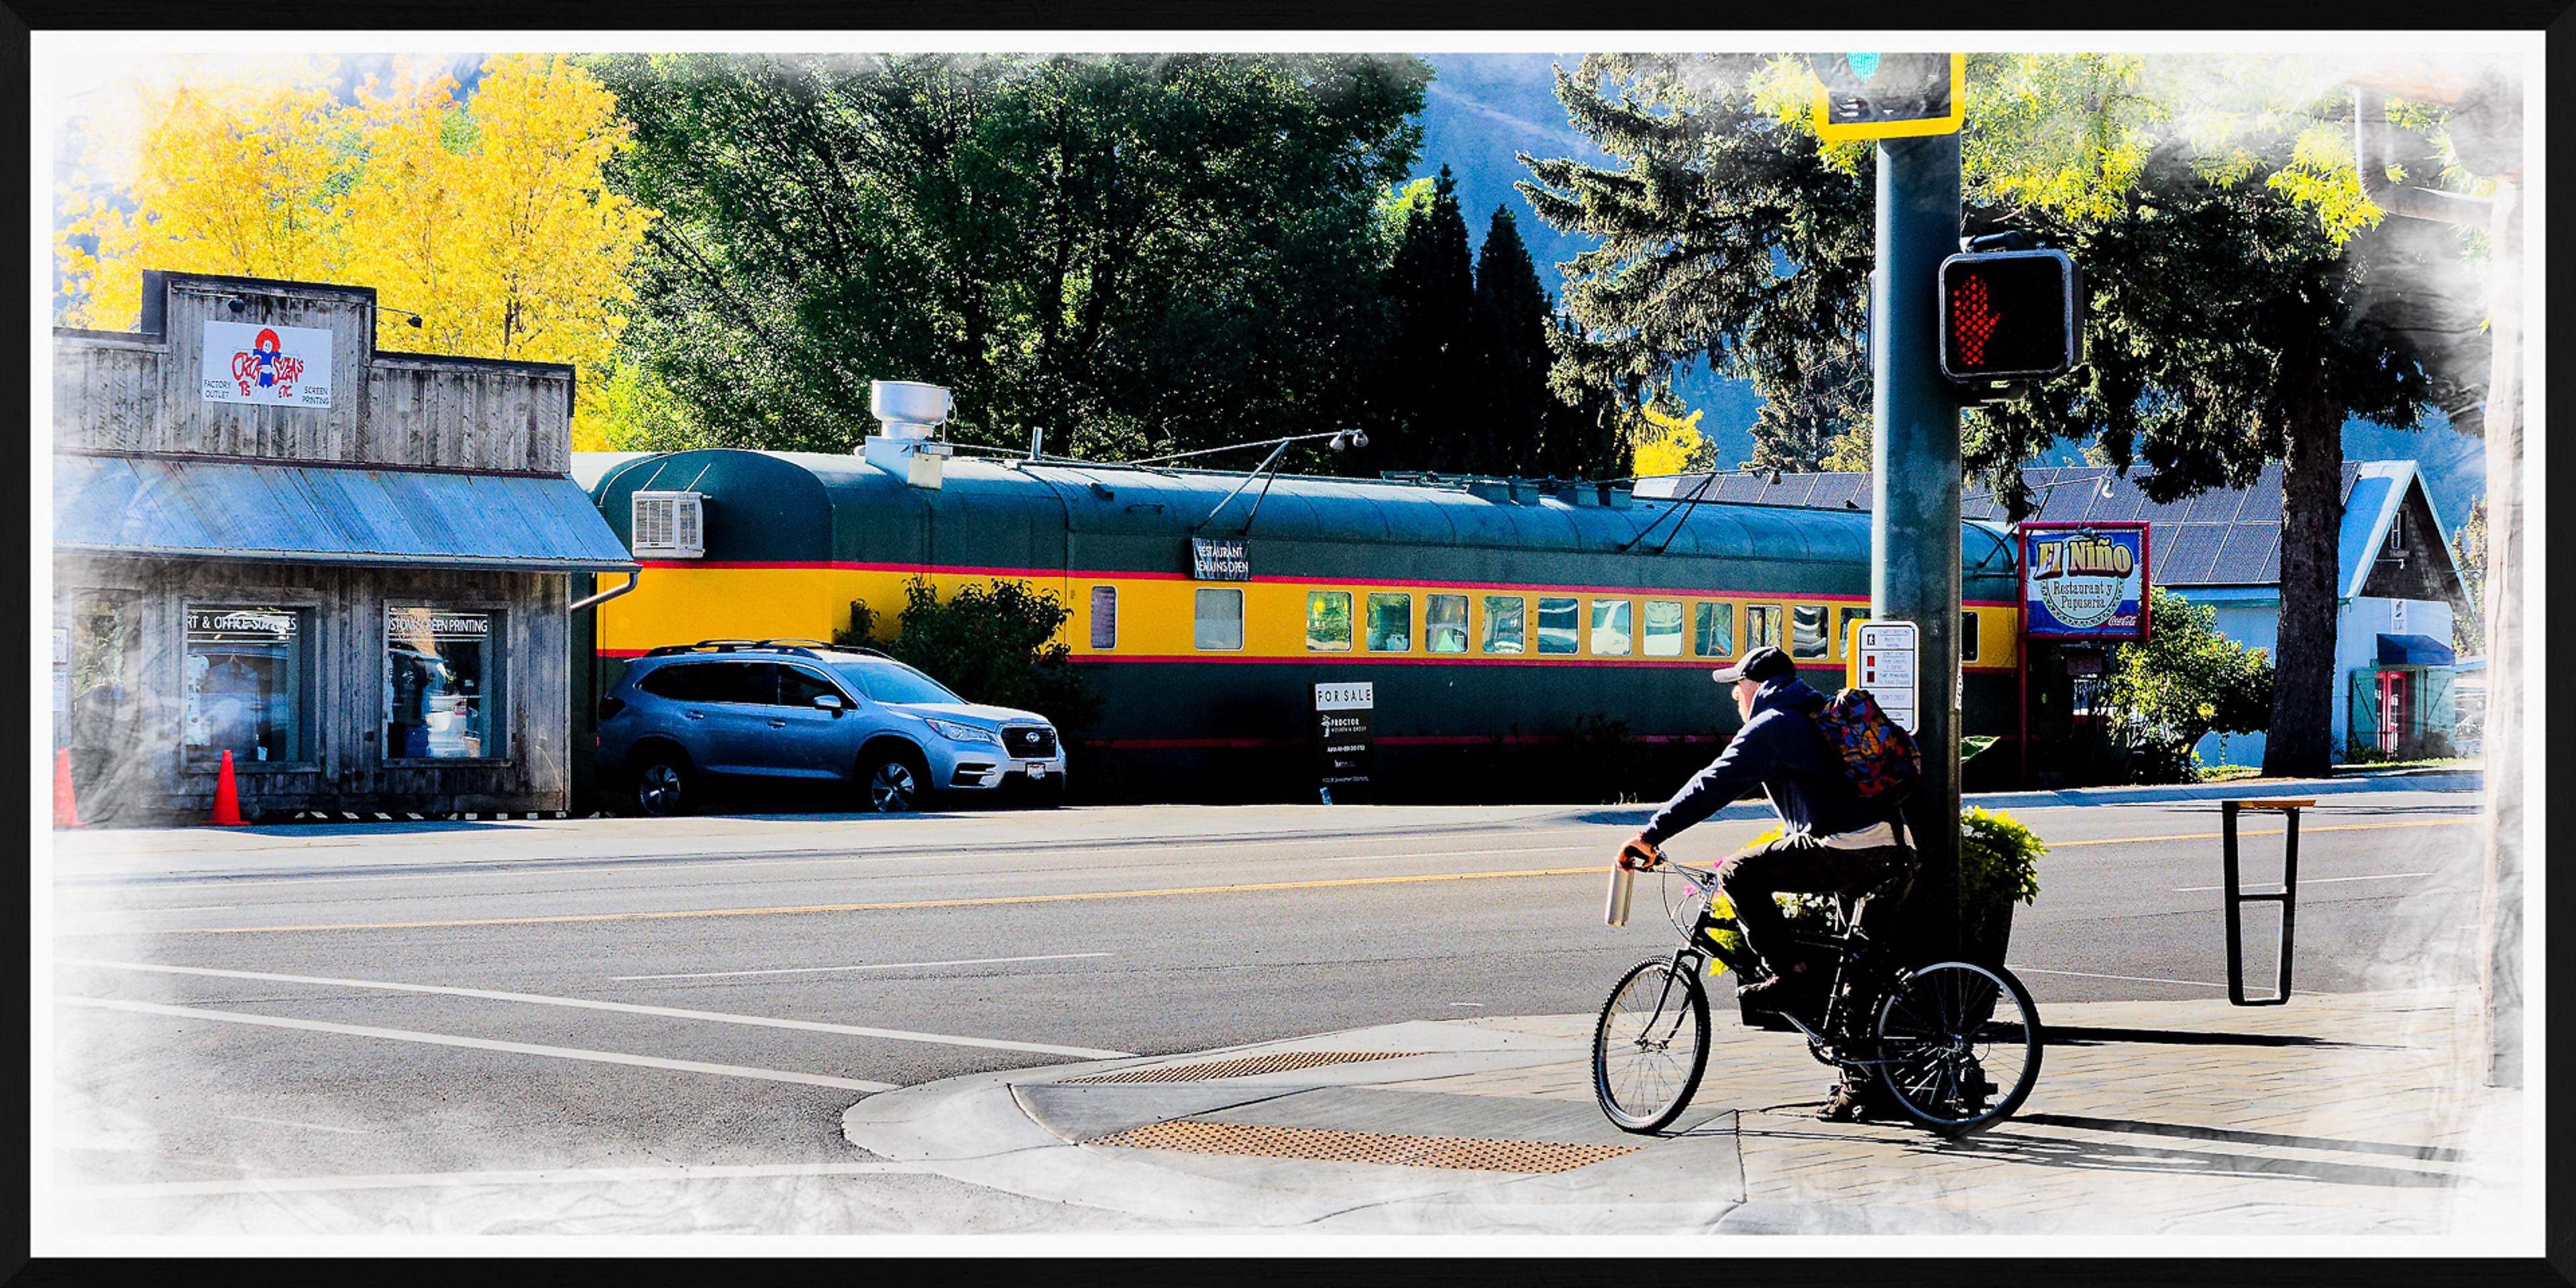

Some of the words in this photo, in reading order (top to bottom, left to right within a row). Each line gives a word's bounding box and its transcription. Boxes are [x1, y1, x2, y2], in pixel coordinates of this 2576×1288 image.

[204, 380, 231, 389] FACTORY
[304, 386, 328, 395] SCREEN
[205, 390, 230, 399] OUTLET
[302, 395, 329, 405] PRINTING
[2035, 542, 2062, 578] El
[2068, 538, 2133, 575] Niño
[1228, 561, 1248, 574] OPEN
[2053, 581, 2104, 596] Restaurant
[2105, 584, 2112, 595] y
[187, 615, 199, 629] RT
[202, 616, 211, 629] &
[214, 616, 250, 630] OFFICE
[252, 617, 297, 631] SUPPLES
[449, 619, 488, 633] PRINTING
[1318, 690, 1340, 702] FOR
[1344, 689, 1371, 702] SALE
